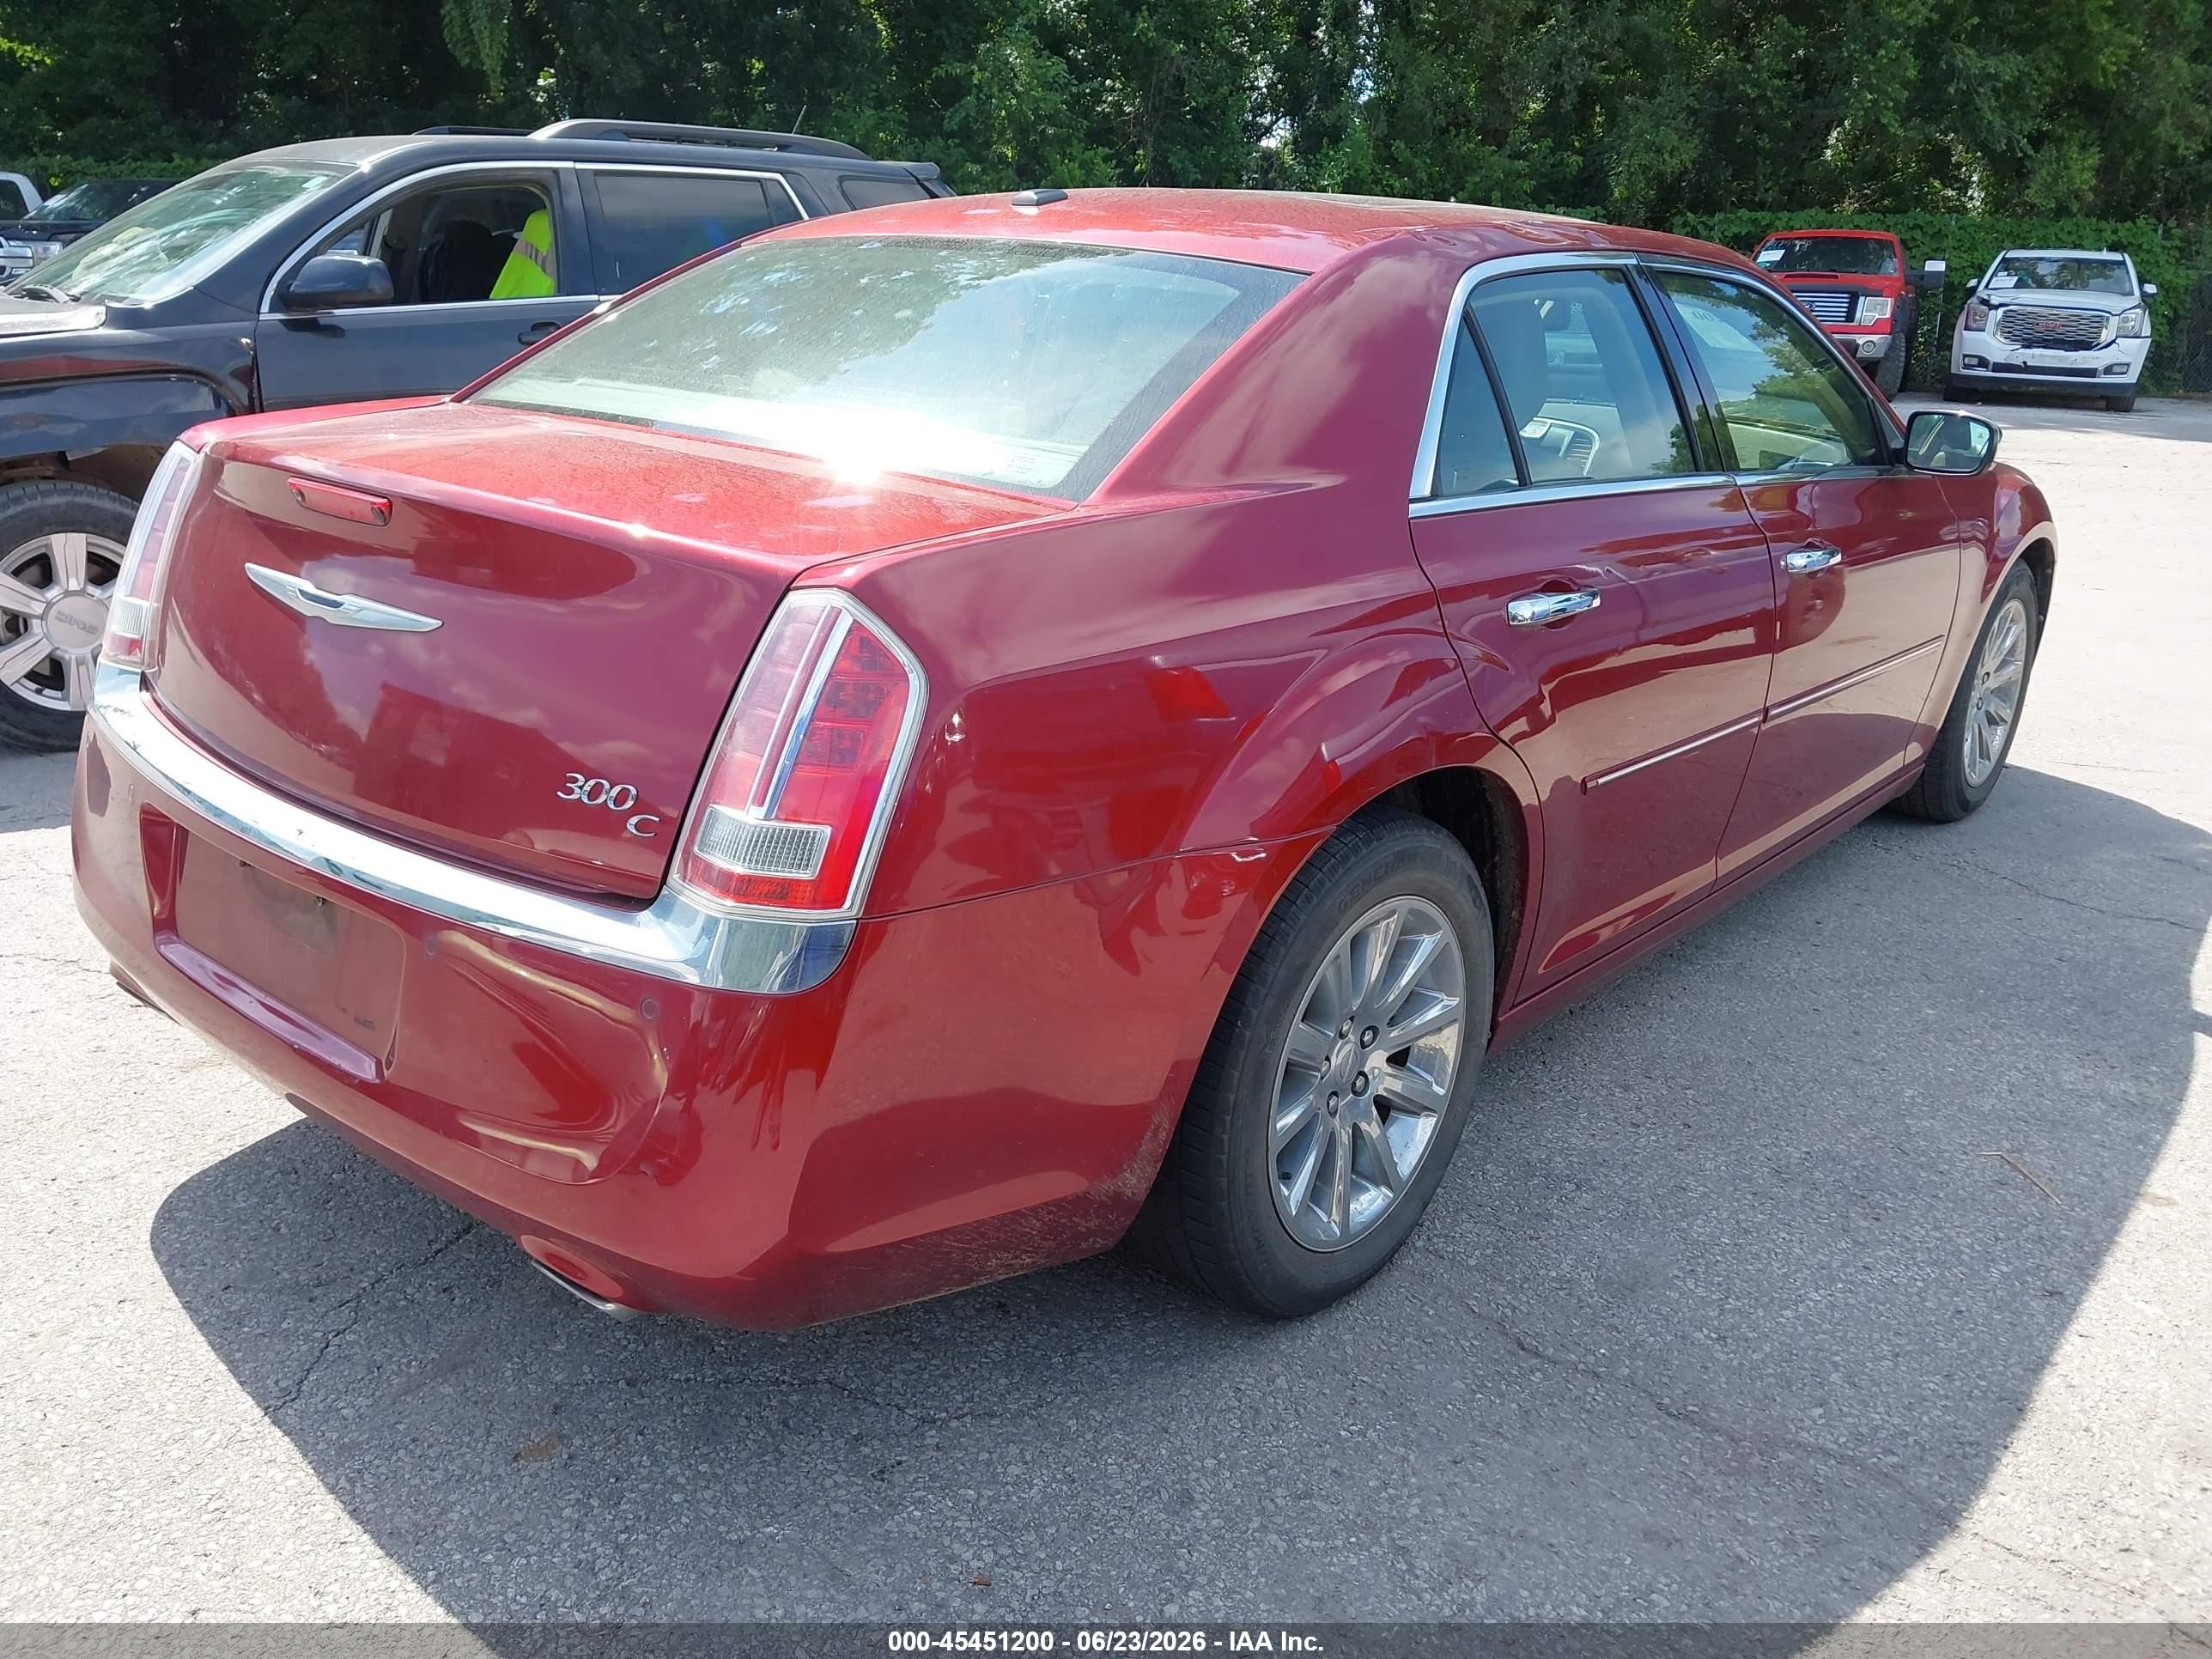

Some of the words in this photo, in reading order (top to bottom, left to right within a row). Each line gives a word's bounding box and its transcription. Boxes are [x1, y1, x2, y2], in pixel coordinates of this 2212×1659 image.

[55, 610, 98, 635] GMC
[556, 773, 638, 811] 300
[626, 814, 660, 837] C
